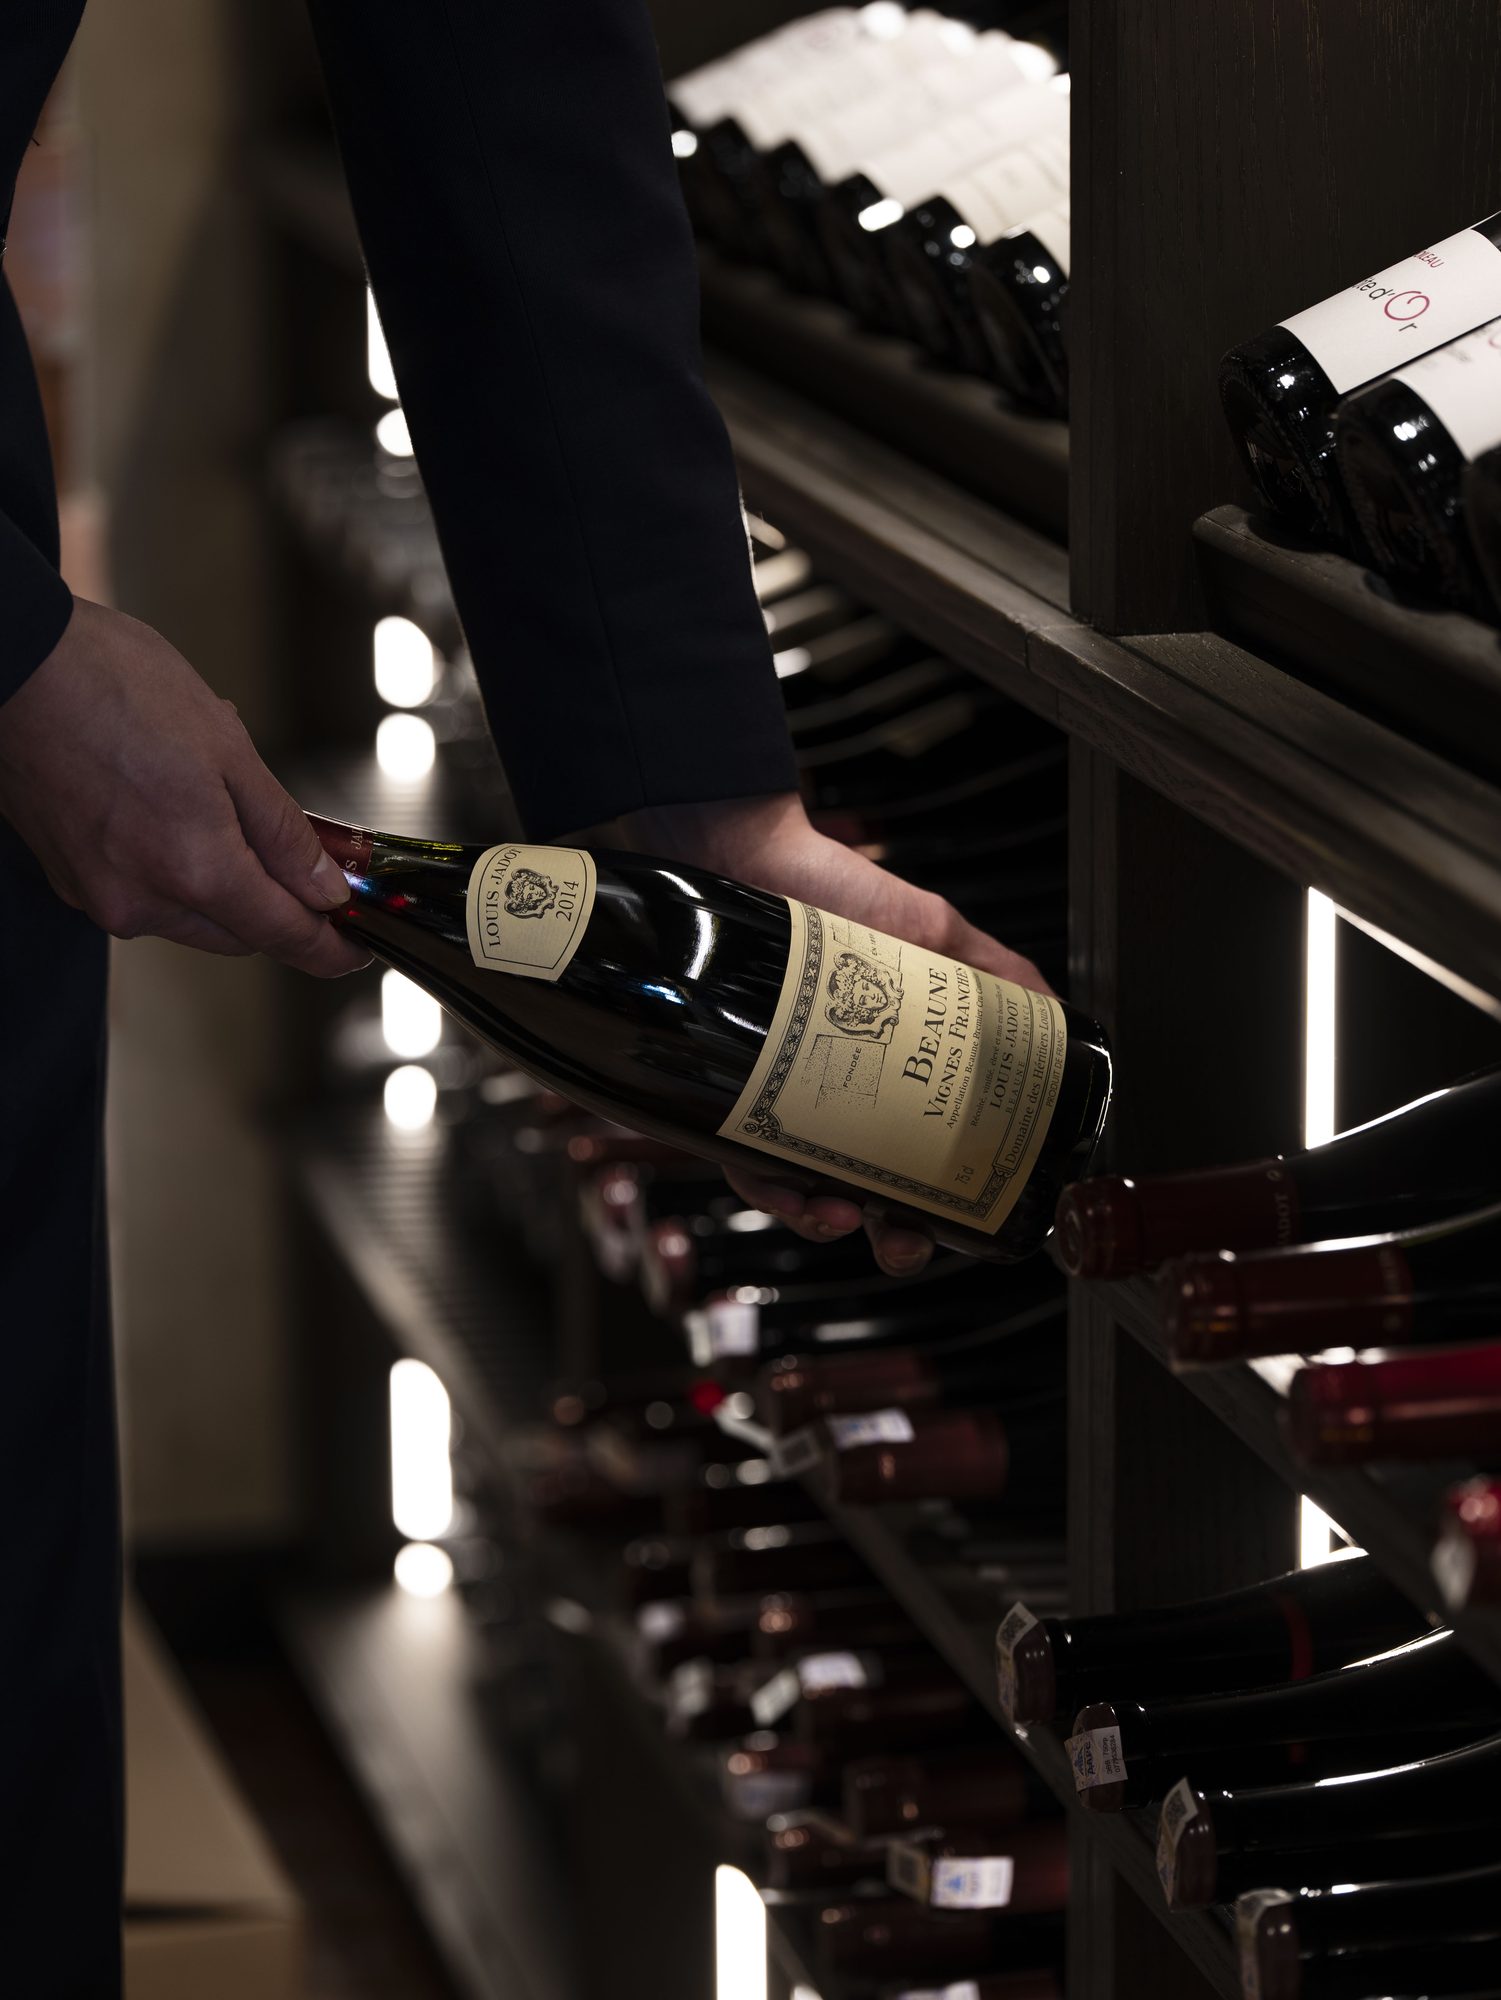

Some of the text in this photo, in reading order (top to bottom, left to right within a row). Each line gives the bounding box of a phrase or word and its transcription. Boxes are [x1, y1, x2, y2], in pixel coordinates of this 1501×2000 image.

[485, 847, 522, 948] LOUIS JADOT
[555, 881, 580, 922] 2014
[901, 966, 948, 1087] BEAUNE
[923, 966, 968, 1118] VIGNES FRANCHES
[988, 997, 1017, 1108] LOUIS JADOT
[1031, 1030, 1046, 1079] Héritiers
[945, 1075, 970, 1128] Appellation
[963, 1041, 979, 1073] Beaune
[972, 1009, 984, 1039] Premier
[1004, 1060, 1025, 1113] BEAUNE
[1023, 1082, 1041, 1104] des
[1045, 1030, 1064, 1106] PRODUIT DE FRANCE
[1004, 1105, 1035, 1164] Domaine
